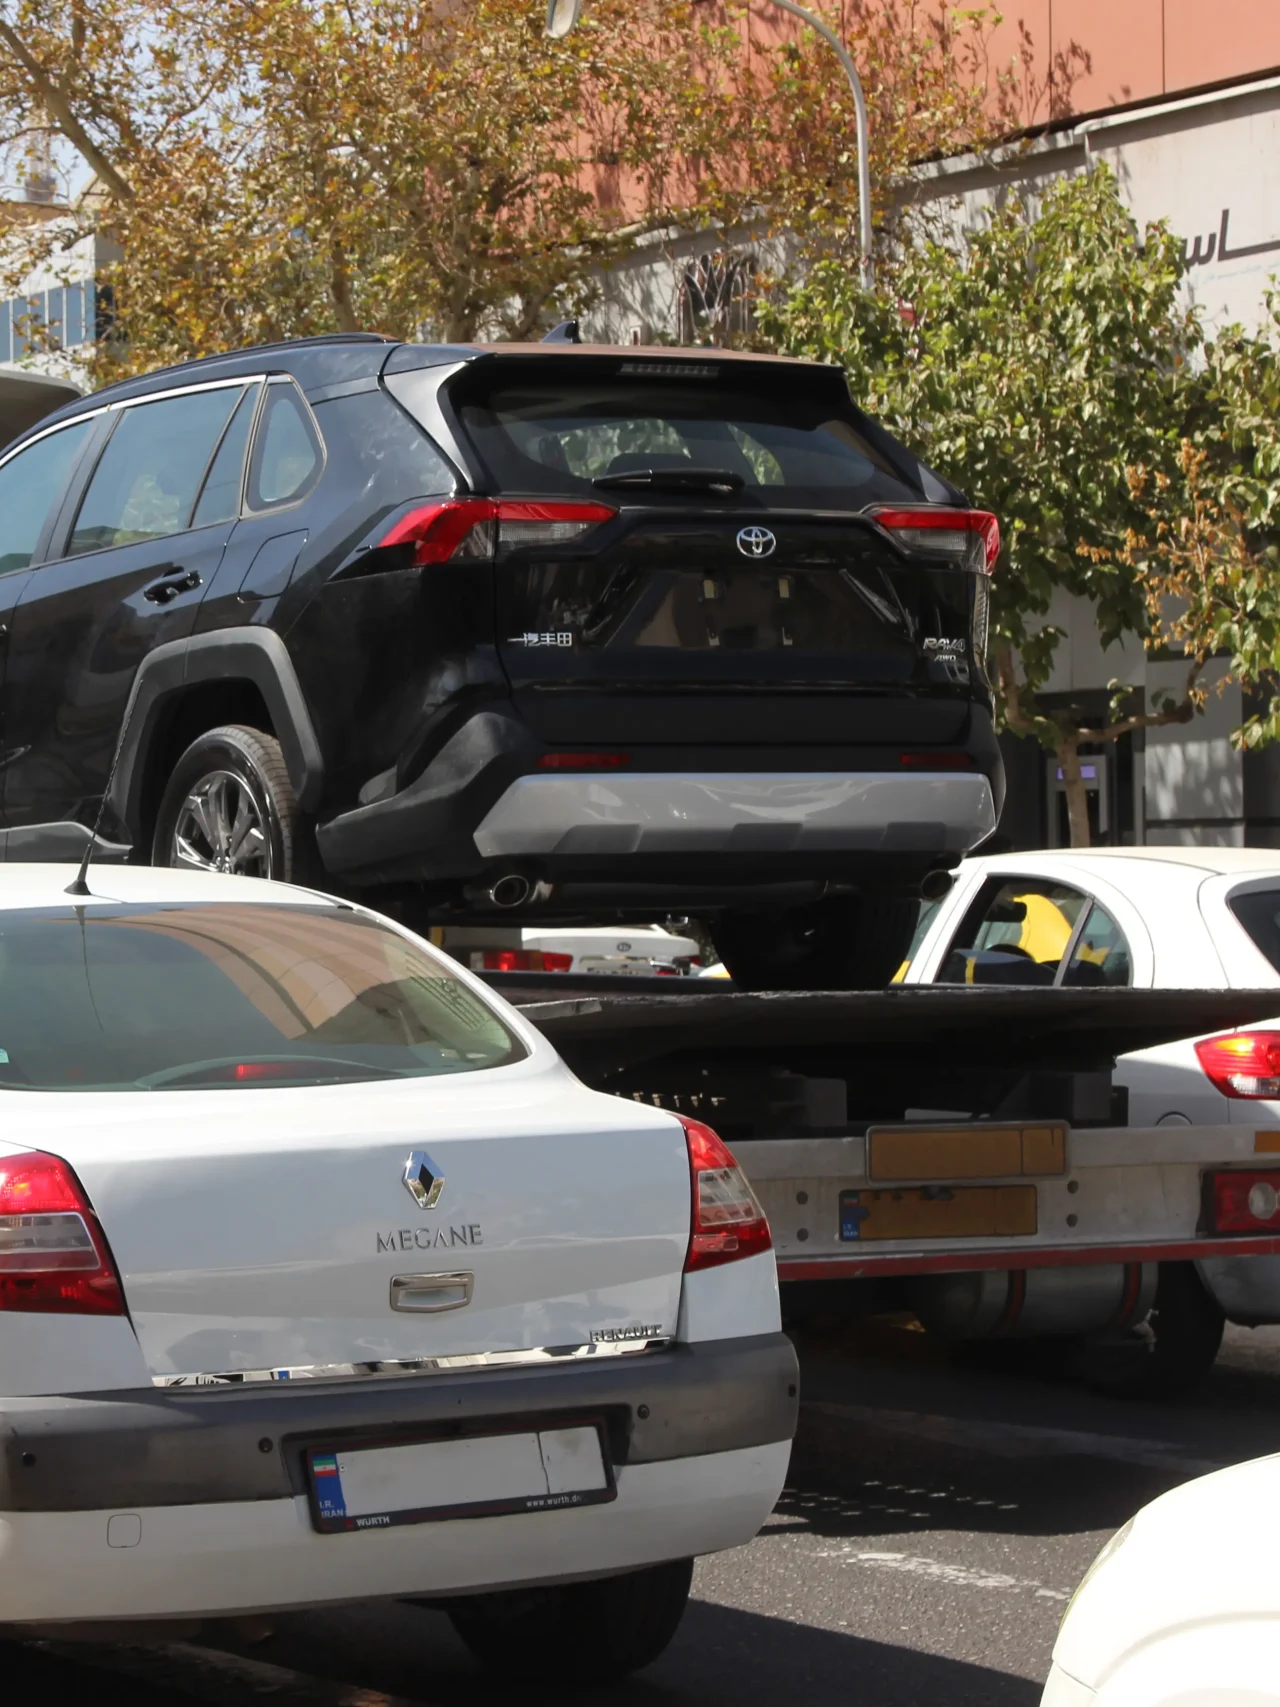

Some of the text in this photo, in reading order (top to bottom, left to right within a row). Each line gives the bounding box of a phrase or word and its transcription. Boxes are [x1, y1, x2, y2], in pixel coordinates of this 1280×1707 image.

[507, 632, 572, 647] 一汽丰田
[923, 637, 966, 652] RAV4
[377, 1224, 483, 1253] MEGANE
[589, 1324, 662, 1341] RENAULT
[321, 1509, 344, 1519] IRAN
